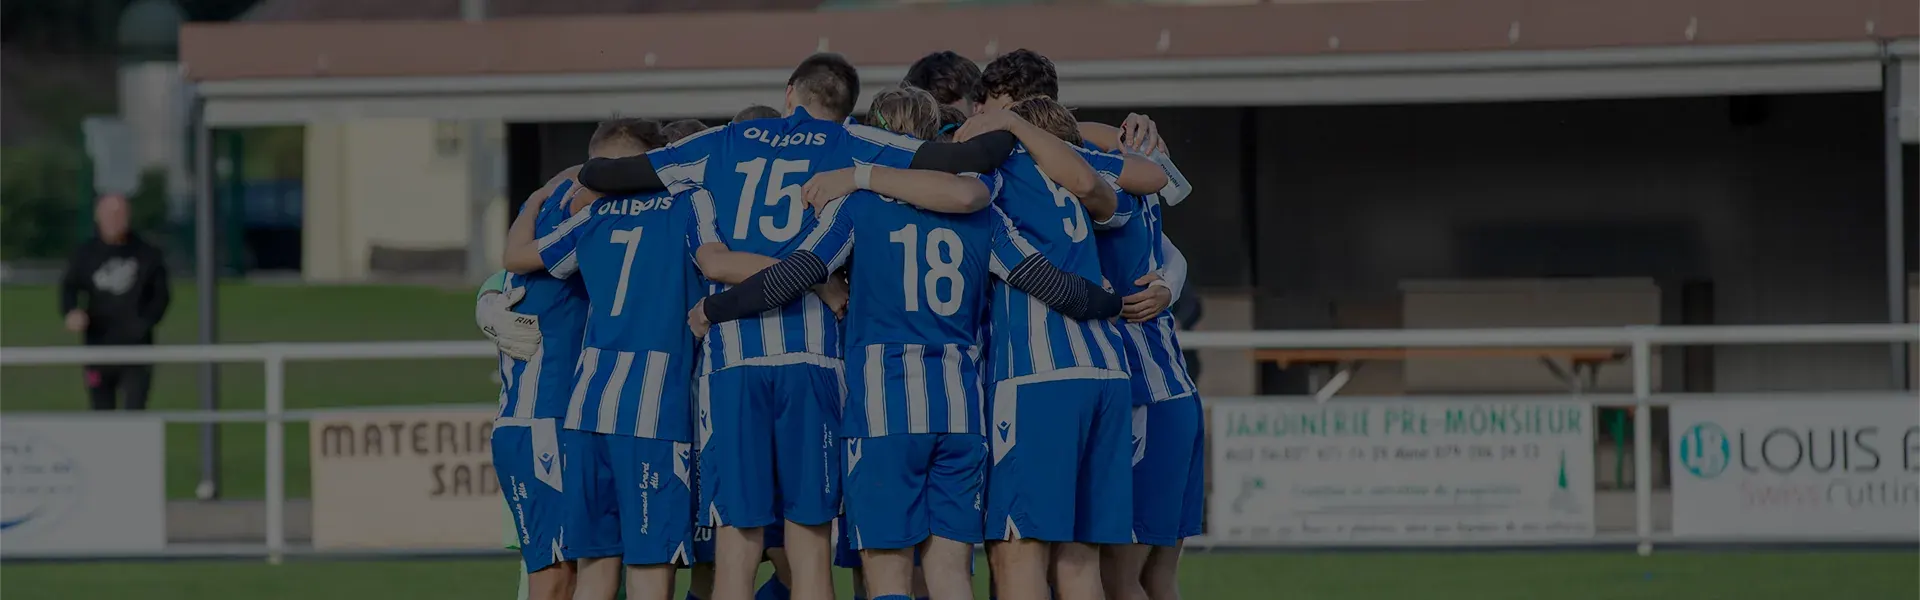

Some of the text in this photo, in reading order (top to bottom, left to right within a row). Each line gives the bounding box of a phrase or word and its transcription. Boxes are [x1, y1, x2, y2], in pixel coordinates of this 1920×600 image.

[743, 127, 827, 148] OLIBOIS
[598, 196, 674, 216] OLIBOIS
[733, 157, 811, 242] 15
[610, 226, 643, 316] 7
[889, 223, 965, 316] 18
[1738, 426, 1881, 475] LOUIS
